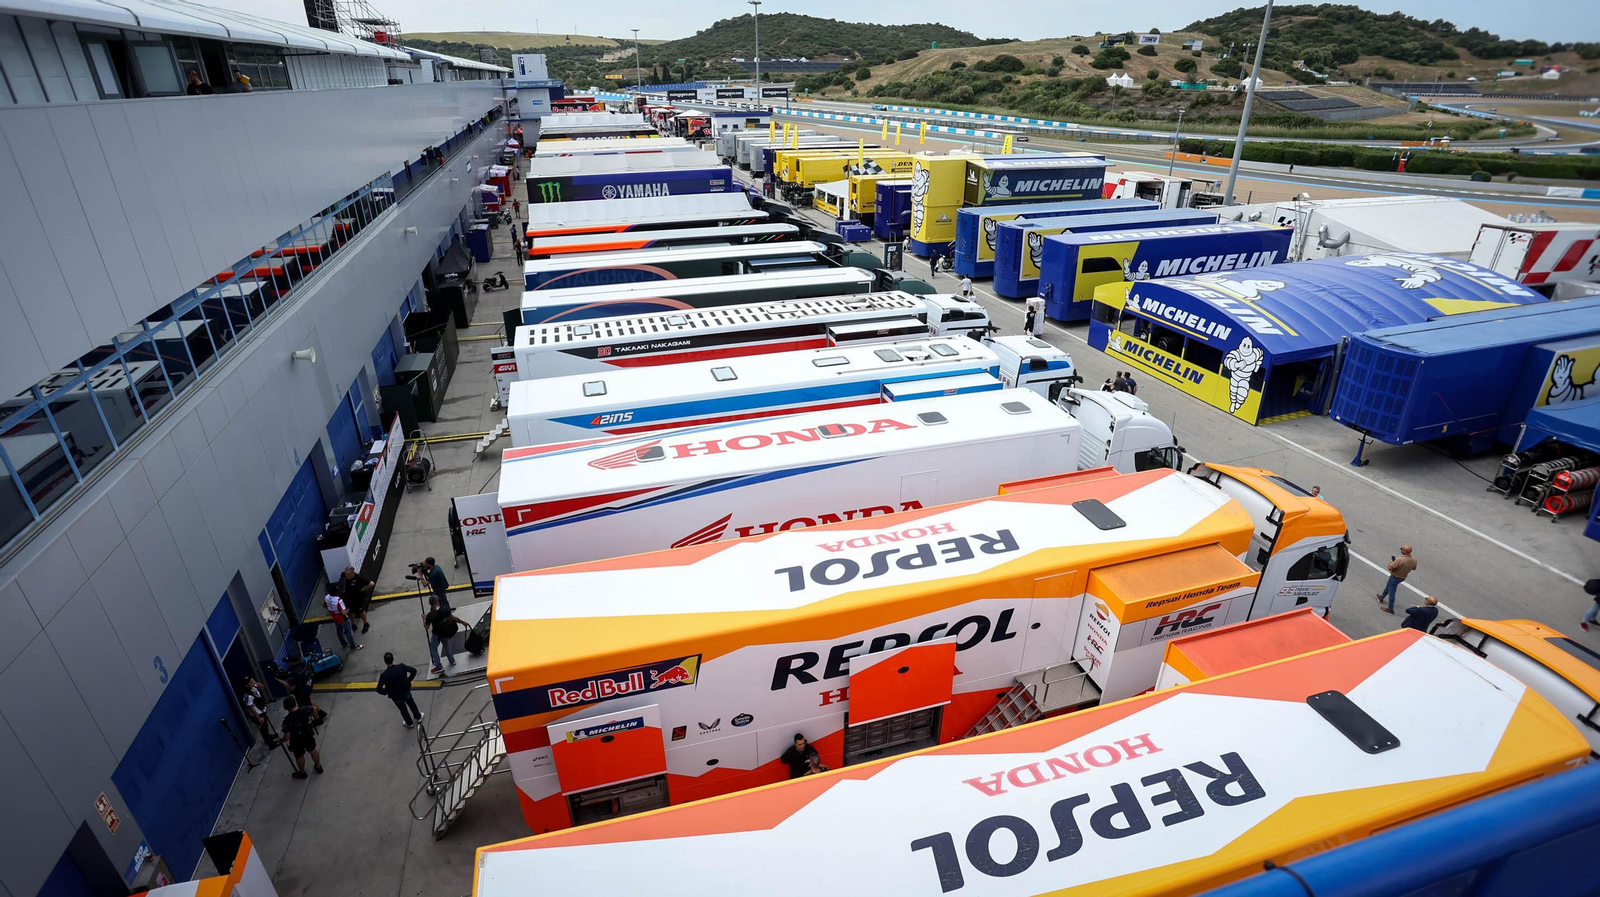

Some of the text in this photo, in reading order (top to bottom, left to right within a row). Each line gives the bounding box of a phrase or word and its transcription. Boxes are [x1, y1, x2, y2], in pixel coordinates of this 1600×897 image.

[616, 182, 670, 199] YAMAHA
[1014, 178, 1102, 192] MICHELIN
[1154, 250, 1278, 277] MICHELIN
[1141, 297, 1232, 341] MICHELIN
[615, 344, 649, 353] TAKAAKI
[651, 340, 691, 349] NAKAGAMI
[1123, 340, 1205, 385] MICHELIN
[669, 418, 918, 459] HONDA
[466, 528, 486, 536] HRC
[815, 522, 957, 552] HONDA
[774, 529, 1020, 592] REPSOL
[1145, 581, 1241, 609] Repsol Honda Team
[1089, 613, 1111, 637] REPSOL
[1150, 622, 1213, 642] Honda RACING
[1153, 603, 1223, 636] HRC
[1087, 623, 1108, 646] HONDA
[1087, 634, 1105, 654] HRC
[153, 655, 169, 685] 3
[548, 671, 645, 708] Red Bull
[588, 721, 638, 736] MICHELIN
[962, 732, 1164, 798] HONDA
[910, 751, 1267, 893] REPSOL
[134, 845, 144, 863] NO
